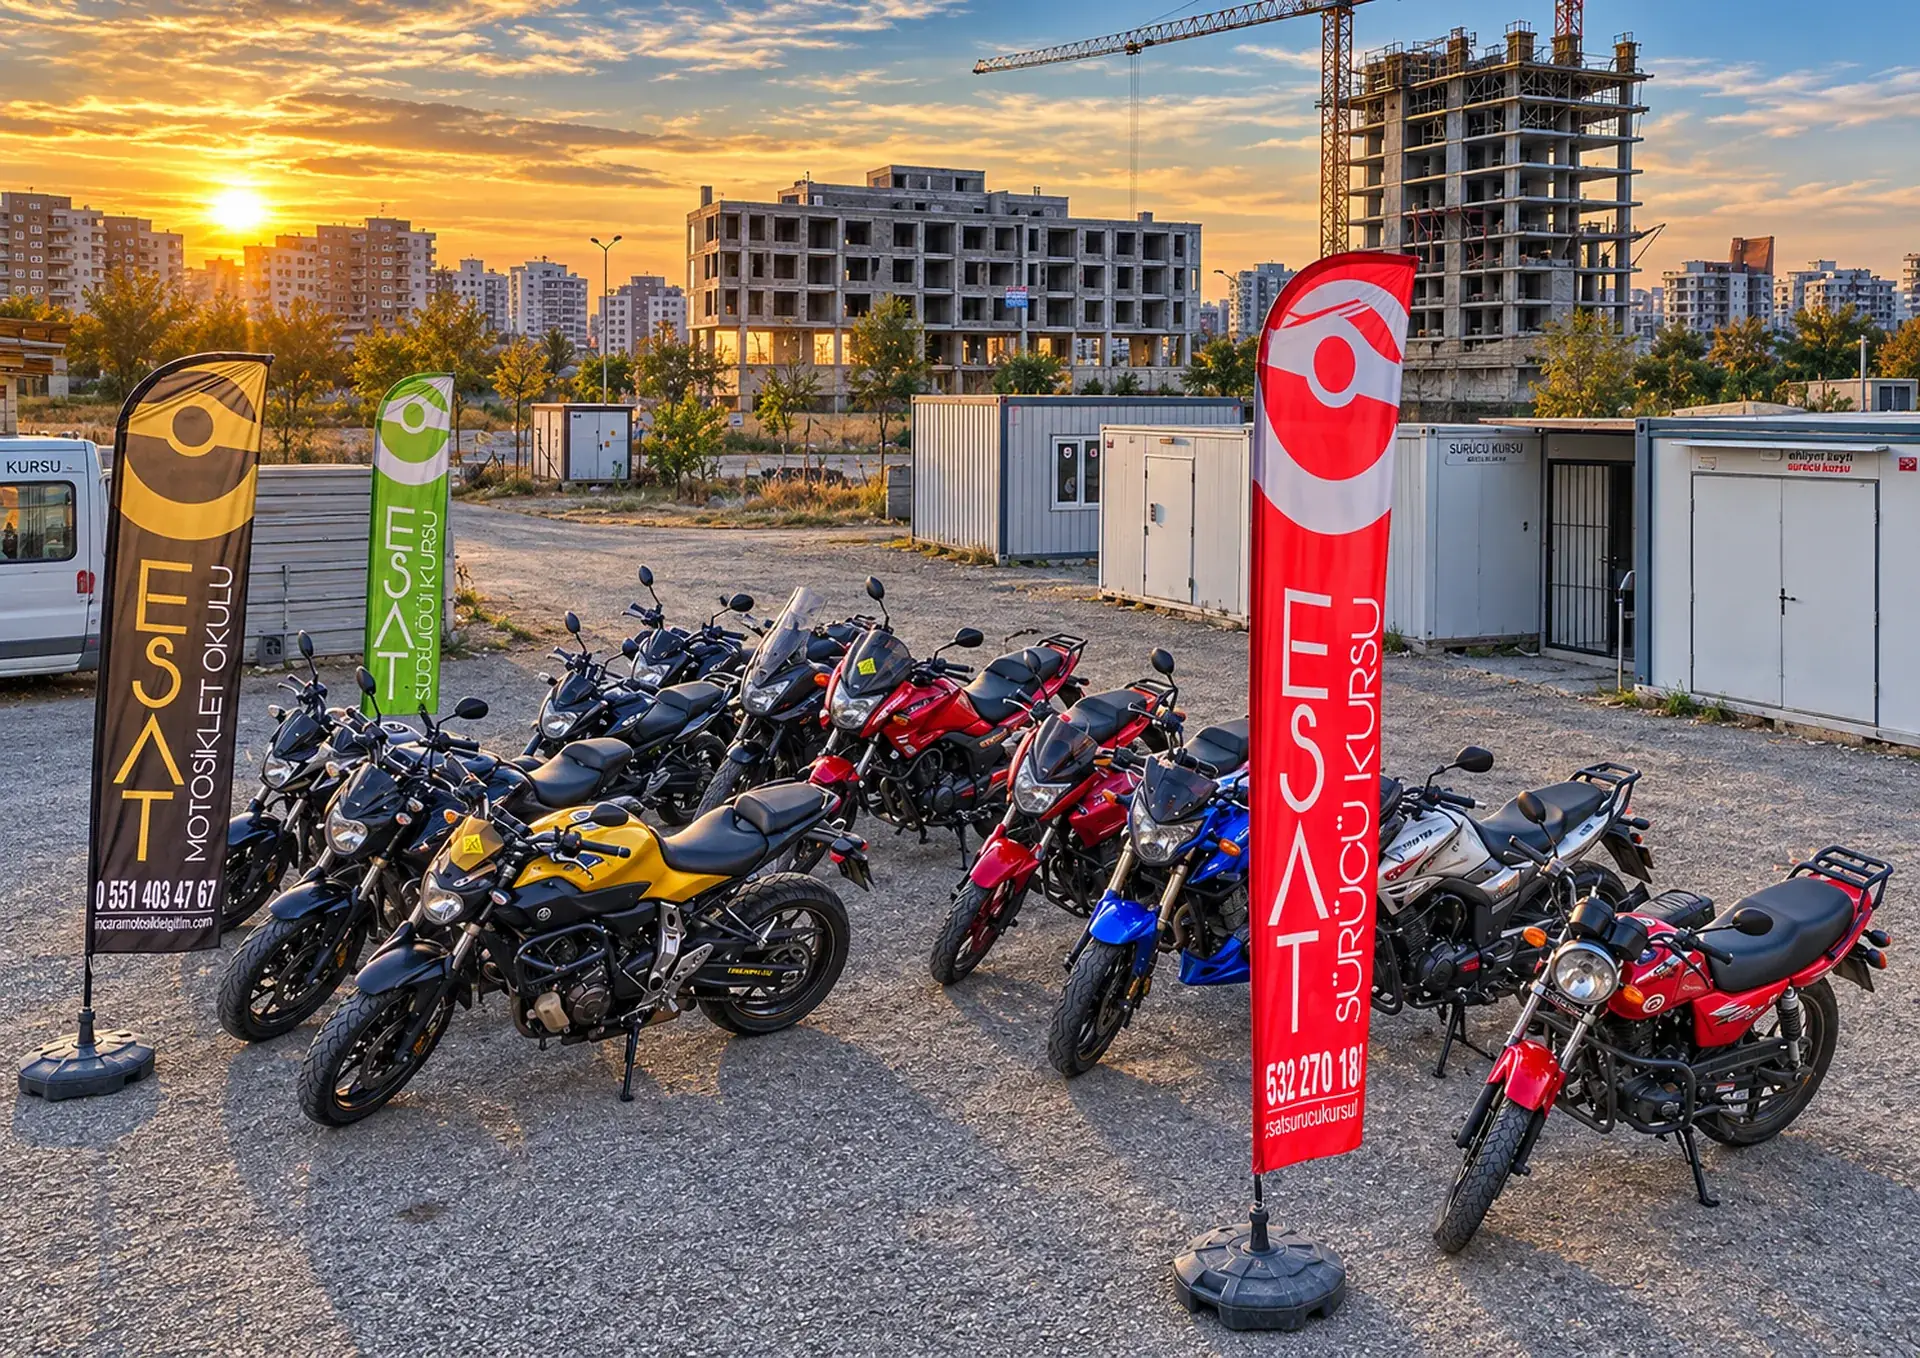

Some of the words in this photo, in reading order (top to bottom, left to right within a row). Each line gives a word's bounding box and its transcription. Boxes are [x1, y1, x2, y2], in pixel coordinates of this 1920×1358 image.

[6, 460, 61, 474] KURSU
[420, 511, 438, 588] KURSU
[203, 565, 233, 673] OKULU
[373, 505, 415, 700] ESAT
[1343, 598, 1380, 782] KURSU
[113, 559, 193, 861] ESAT
[184, 678, 223, 862] MOTOSİKLET
[96, 880, 105, 910] 0
[108, 880, 137, 909] 551
[142, 880, 170, 909] 403
[174, 880, 193, 909] 47
[197, 880, 217, 908] 67
[1267, 588, 1332, 1034] ESAT
[1332, 801, 1370, 1023] SÜRÜCÜ
[1266, 1058, 1295, 1106] 532
[1300, 1050, 1332, 1096] 270
